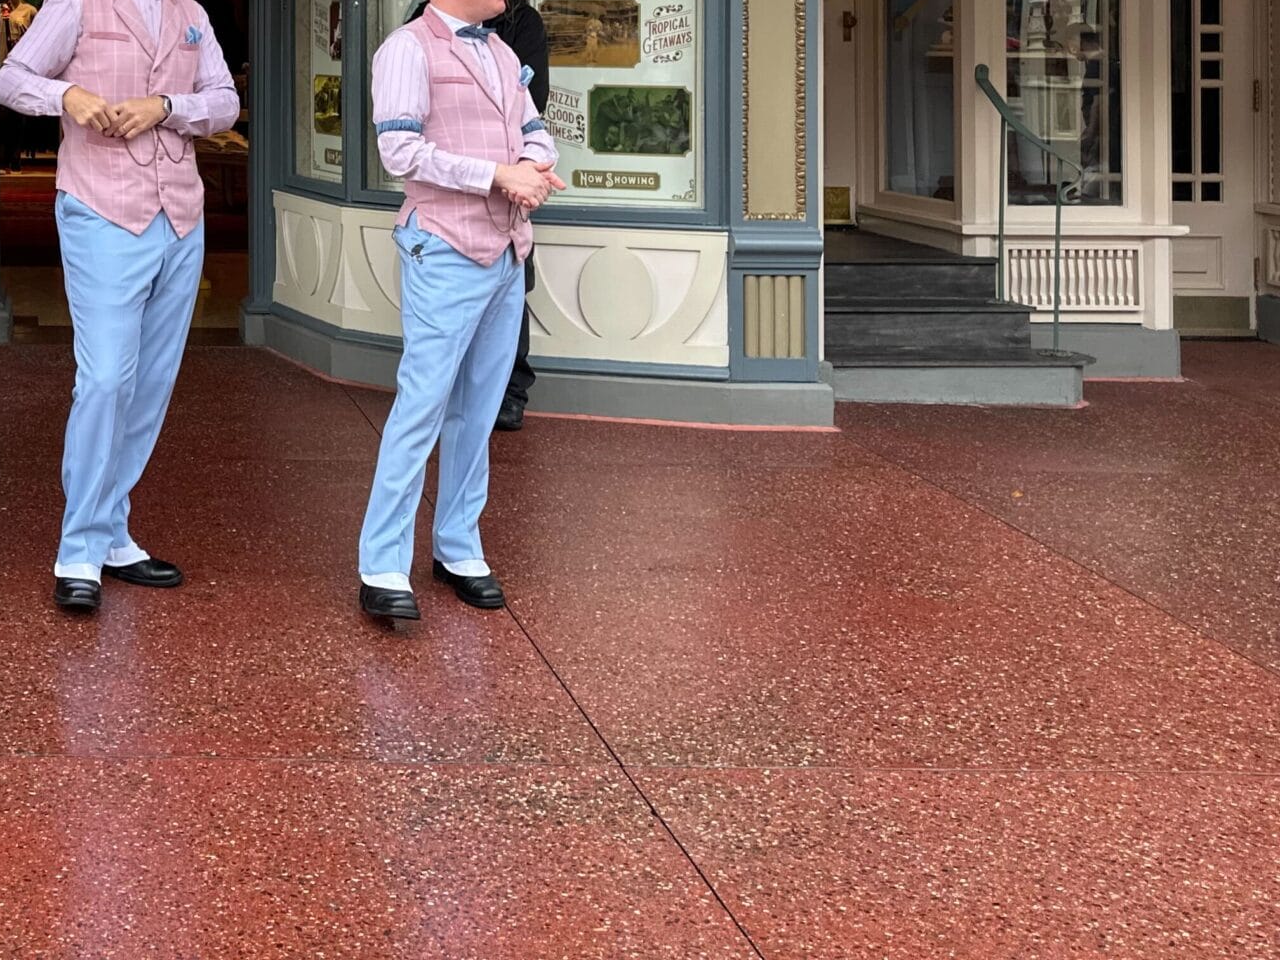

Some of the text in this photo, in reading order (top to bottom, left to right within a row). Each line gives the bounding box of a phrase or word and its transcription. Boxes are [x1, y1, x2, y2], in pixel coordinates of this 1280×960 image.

[644, 16, 691, 36] TROPICAL
[643, 32, 692, 55] GETAWAYS
[549, 91, 580, 108] RIZZLY
[547, 103, 575, 124] GOOD
[546, 119, 573, 141] TIMES
[580, 170, 655, 188] NOW SHOWING
